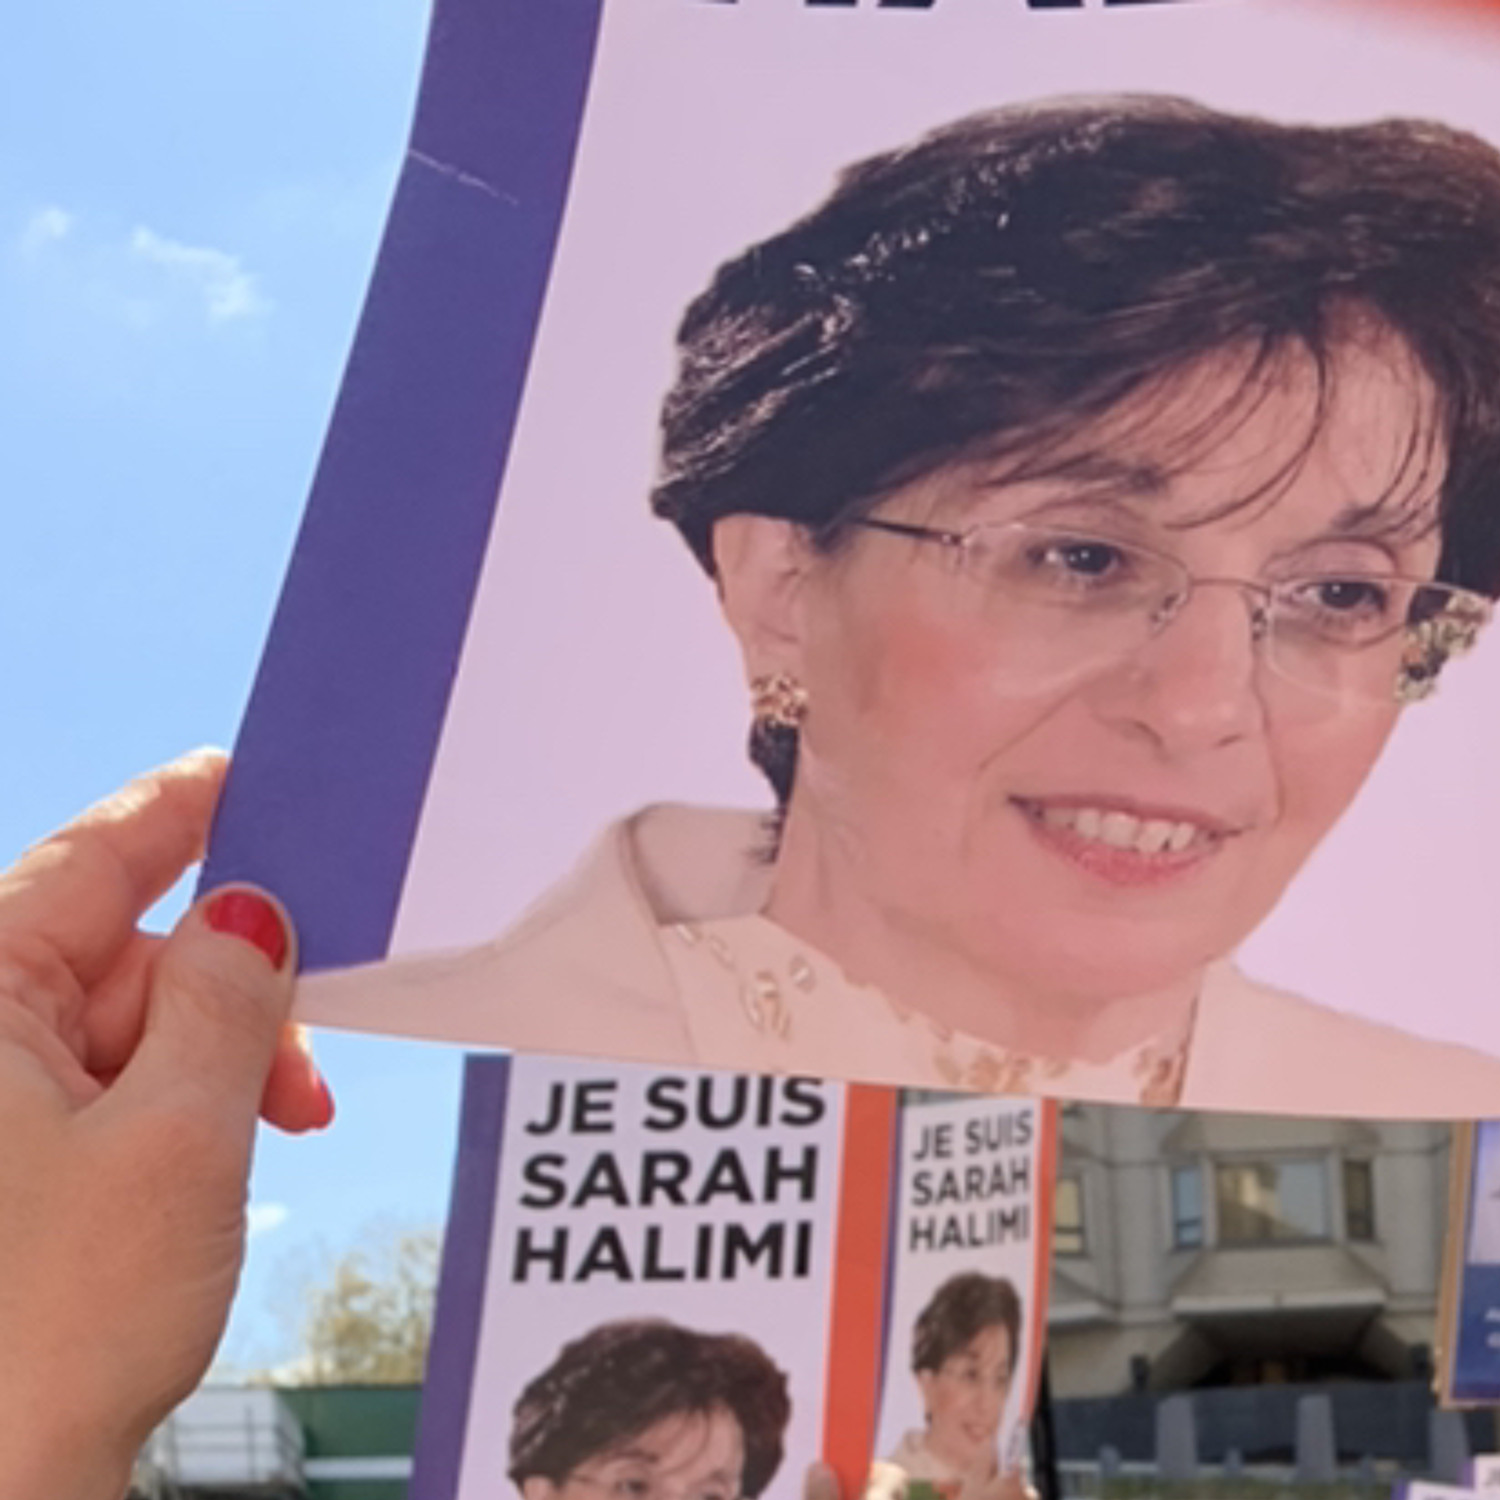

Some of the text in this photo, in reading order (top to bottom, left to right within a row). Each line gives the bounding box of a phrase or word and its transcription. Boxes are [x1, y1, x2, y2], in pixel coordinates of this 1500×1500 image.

[525, 1075, 826, 1136] JE SUIS
[913, 1109, 1034, 1162] JE SUIS
[518, 1145, 820, 1209] SARAH
[911, 1159, 1031, 1208] SARAH
[511, 1220, 812, 1284] HALIMI
[908, 1206, 1030, 1253] HALIMI
